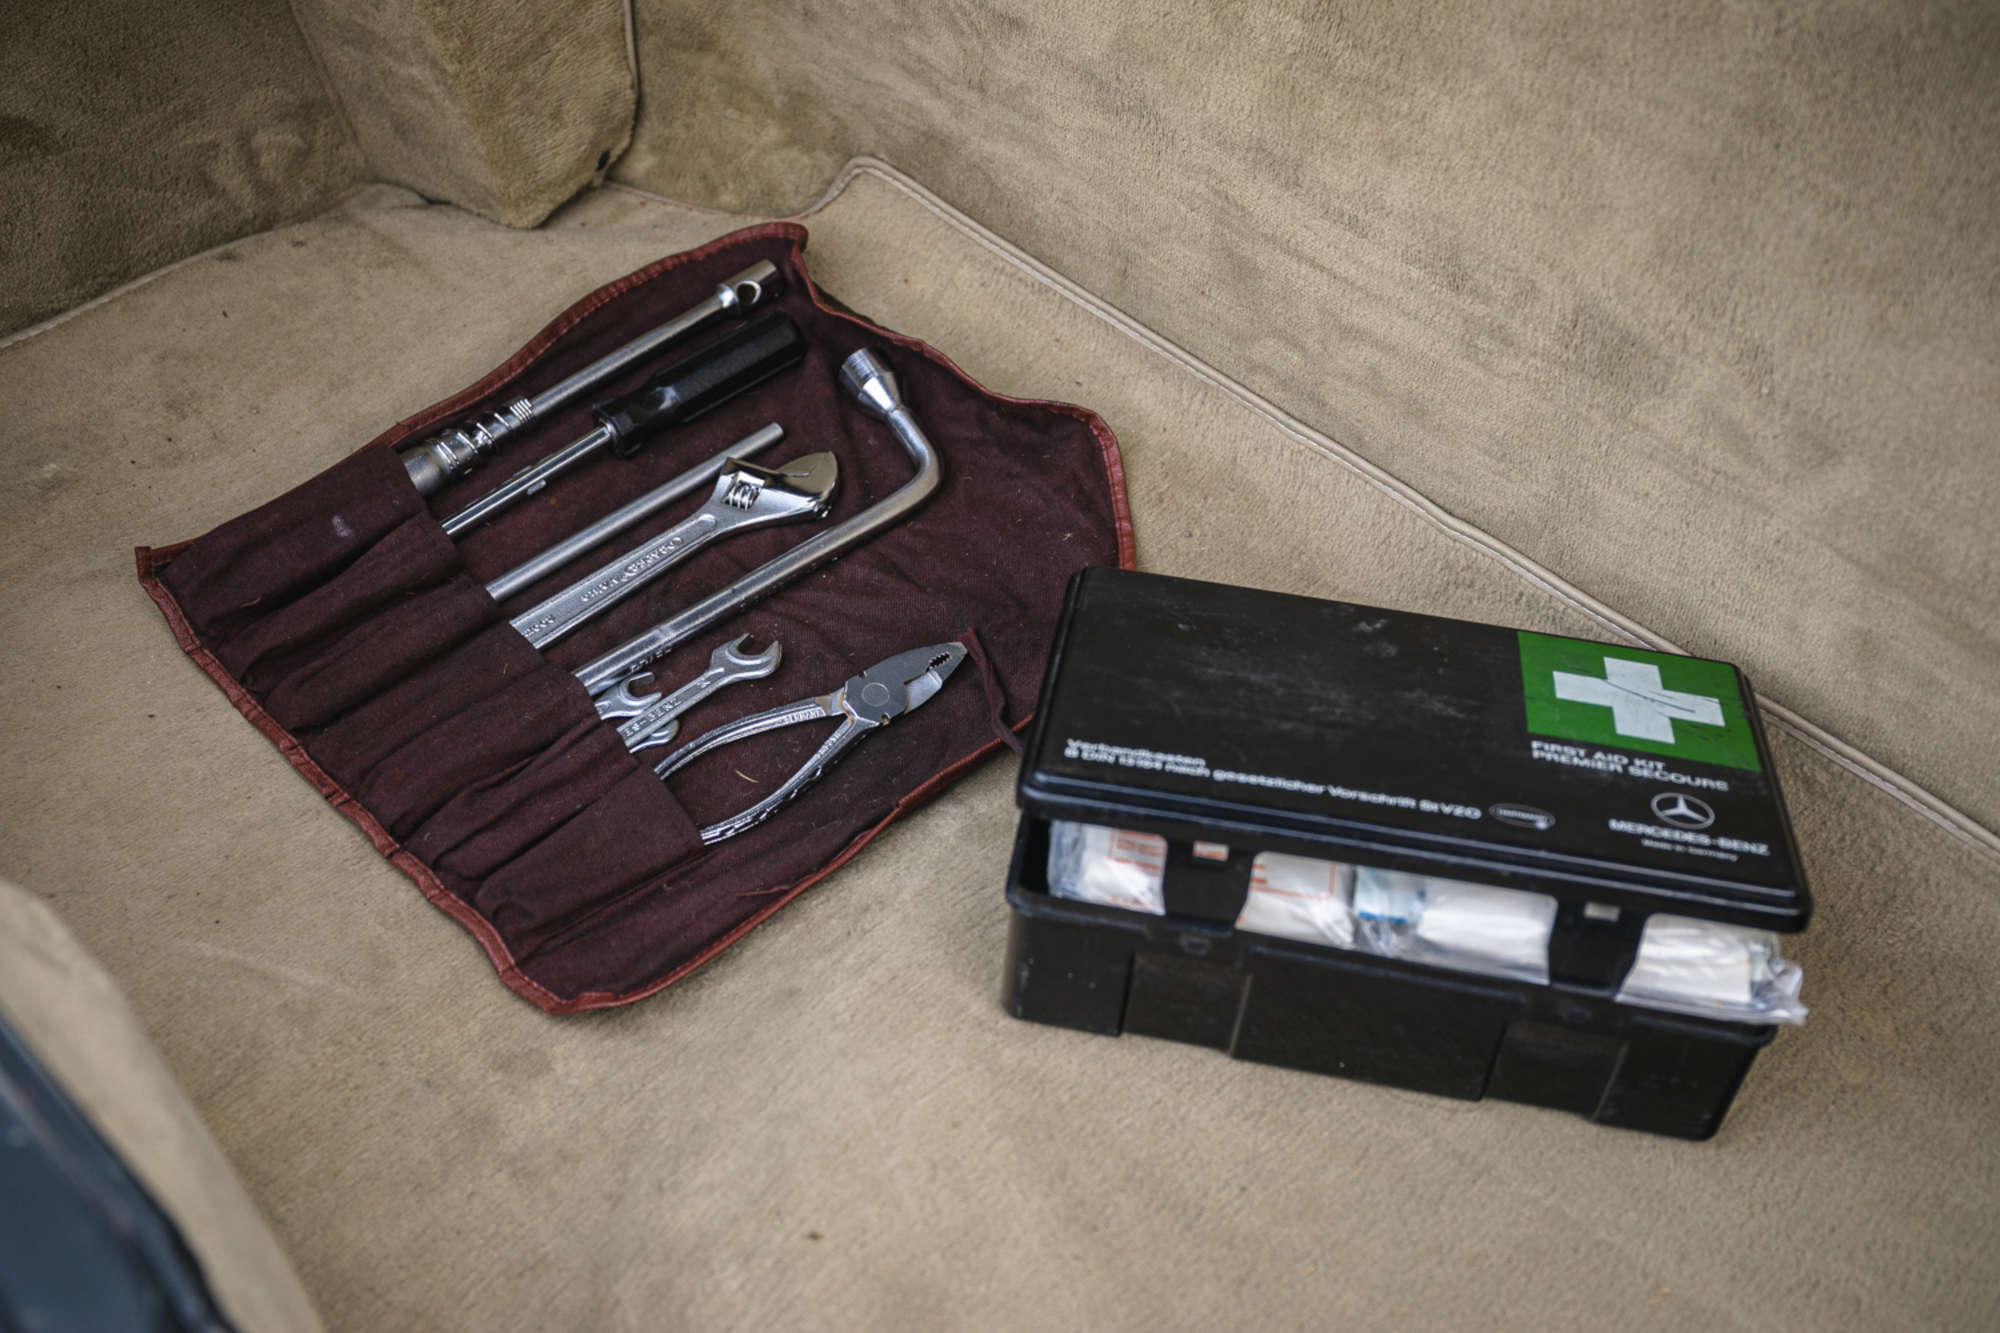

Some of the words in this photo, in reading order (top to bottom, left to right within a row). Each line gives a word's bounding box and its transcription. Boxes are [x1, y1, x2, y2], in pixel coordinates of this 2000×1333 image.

[1531, 740, 1588, 760] FIRST
[1593, 750, 1629, 766] AID
[1633, 757, 1667, 771] KIT
[1532, 750, 1624, 775] PREMIER
[1628, 766, 1729, 792] SECOURS
[1165, 760, 1211, 778] nach
[1213, 769, 1327, 795] gesetzlicher
[1327, 783, 1417, 811] Vorschrift
[1418, 799, 1483, 820] StVZO
[1687, 846, 1739, 863] Germany
